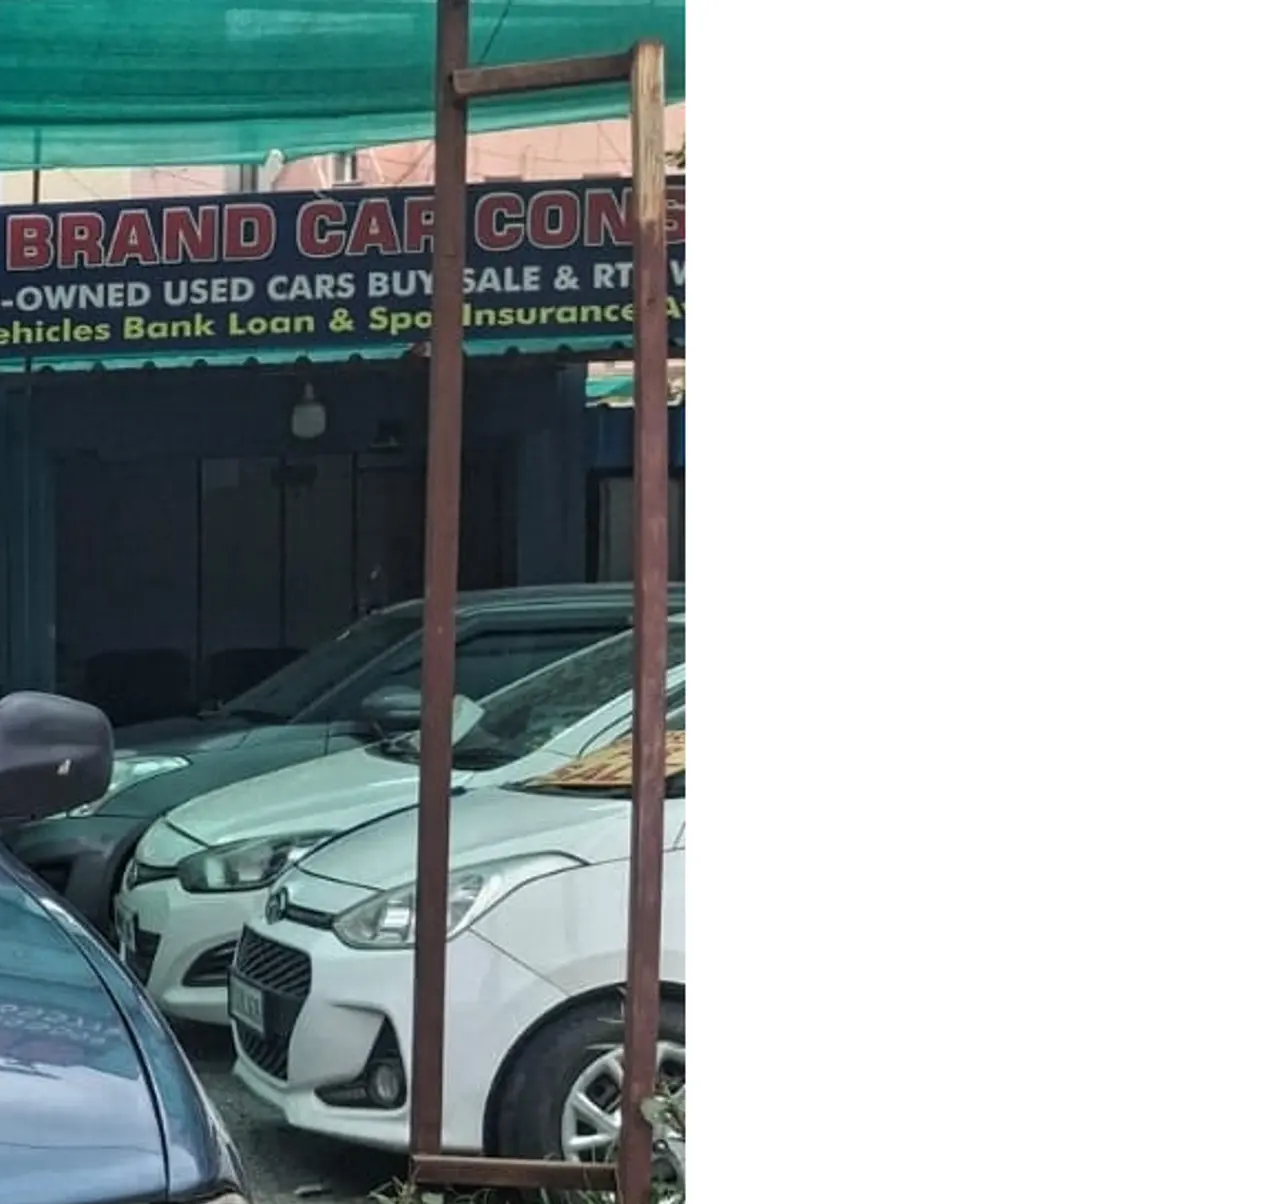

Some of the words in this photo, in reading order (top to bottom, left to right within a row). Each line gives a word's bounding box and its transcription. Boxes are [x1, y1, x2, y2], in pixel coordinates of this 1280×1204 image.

[6, 203, 277, 271] BRAND
[163, 277, 255, 306] USED
[266, 272, 356, 301] CARS
[367, 269, 435, 299] BUY
[553, 264, 580, 292] &
[593, 261, 635, 290] RT
[122, 313, 216, 341] Bank
[228, 312, 315, 336] Loan
[328, 307, 355, 334] &
[368, 306, 433, 335] Spo
[462, 301, 634, 327] Insurance
